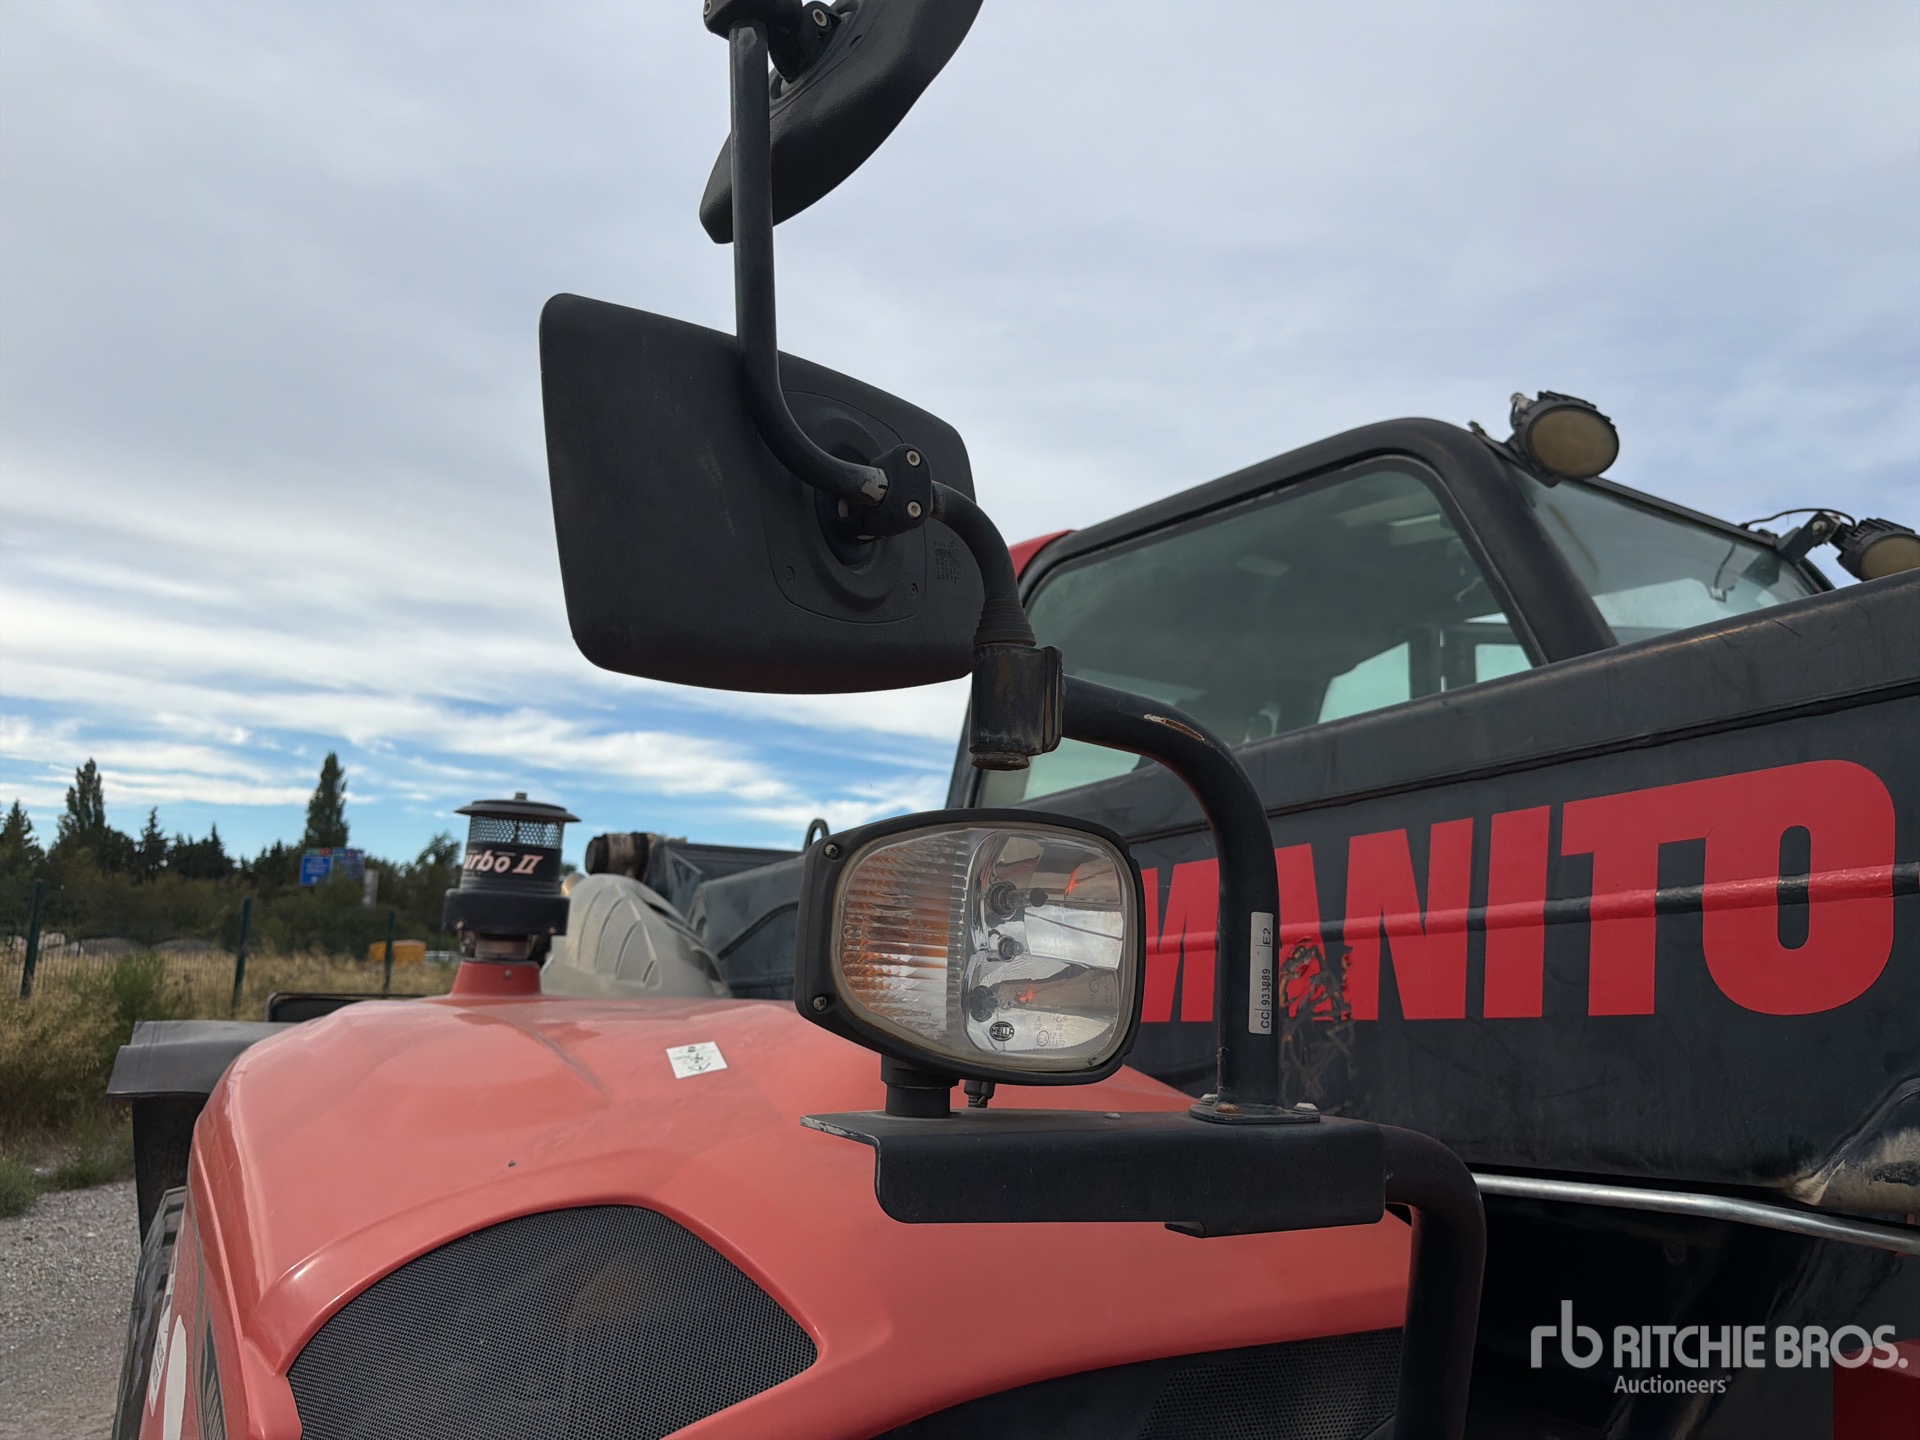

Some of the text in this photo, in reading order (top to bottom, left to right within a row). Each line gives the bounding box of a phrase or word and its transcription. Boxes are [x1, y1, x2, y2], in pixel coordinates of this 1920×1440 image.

[512, 854, 544, 874] II
[1261, 928, 1271, 1028] CC 933889 E2
